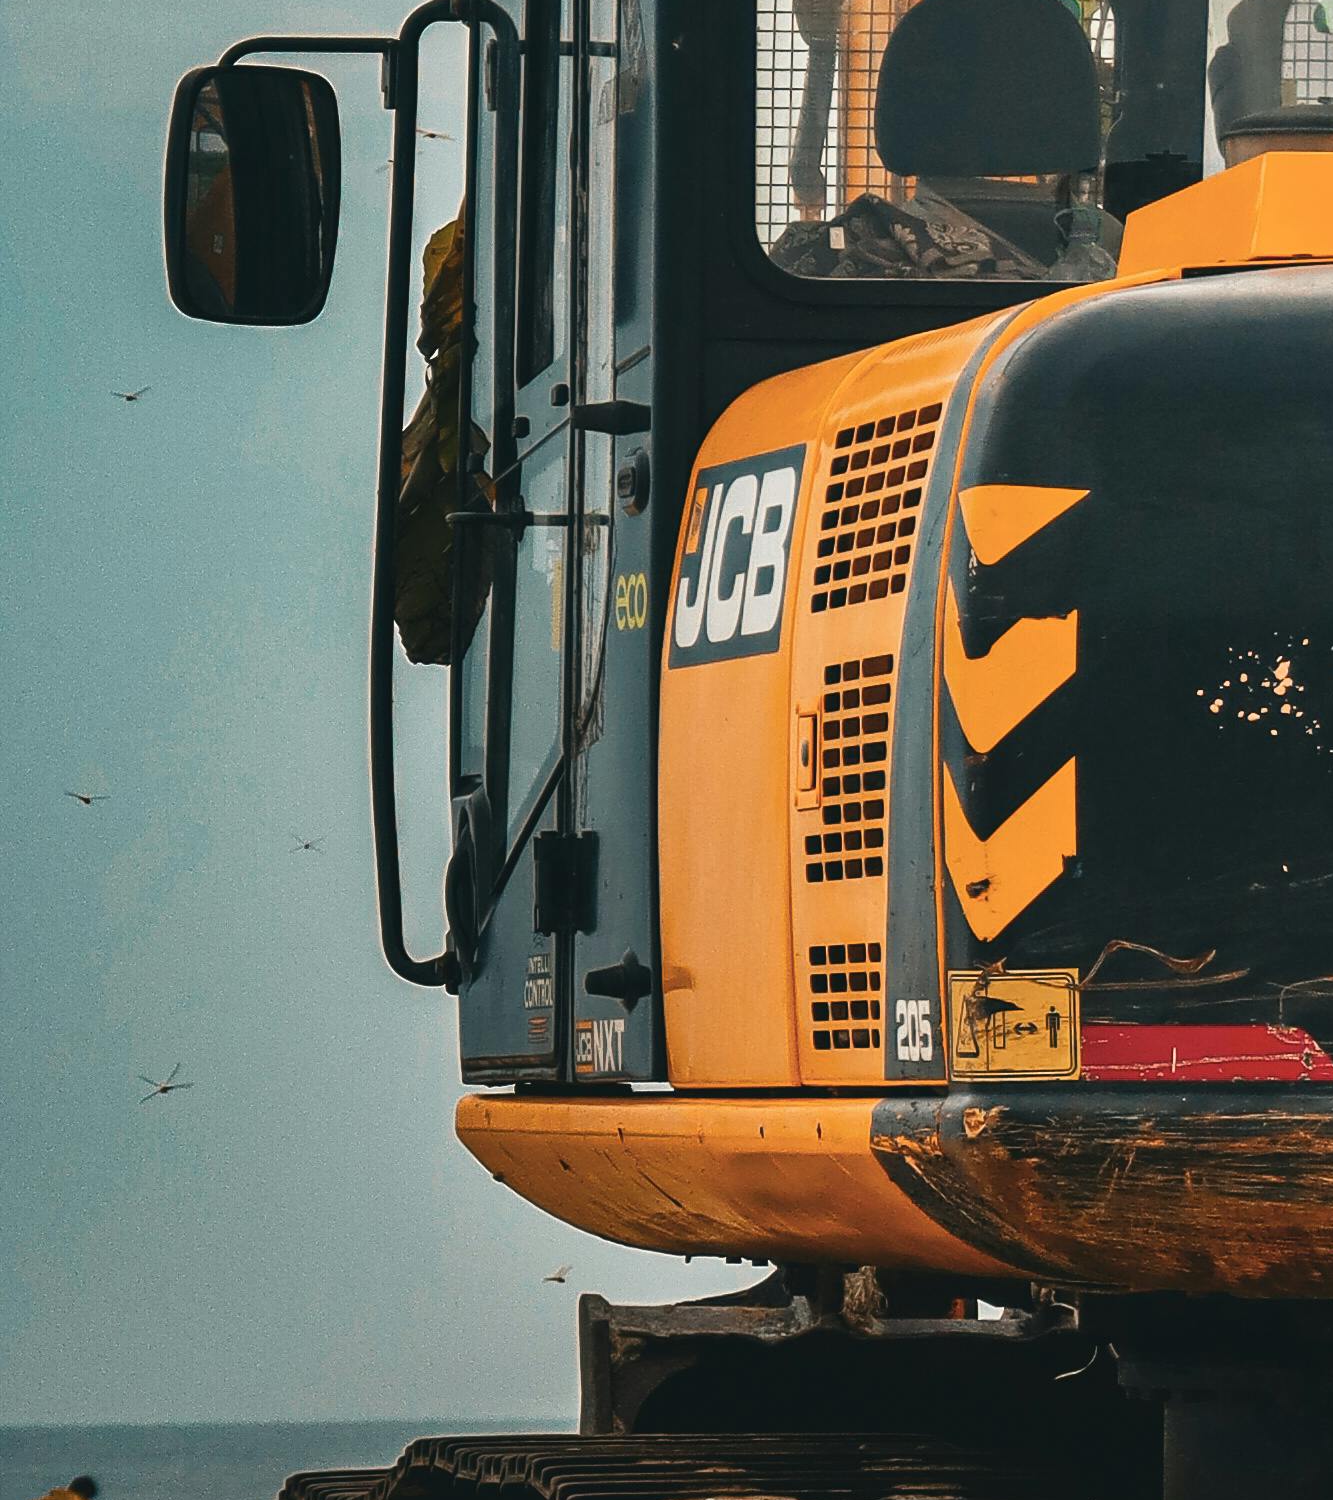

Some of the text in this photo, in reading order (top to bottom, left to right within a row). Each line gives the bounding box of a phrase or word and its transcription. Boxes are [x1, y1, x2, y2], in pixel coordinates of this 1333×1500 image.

[674, 466, 796, 648] JCB
[615, 572, 648, 631] eco
[593, 1018, 625, 1072] NXT
[896, 999, 933, 1062] 205
